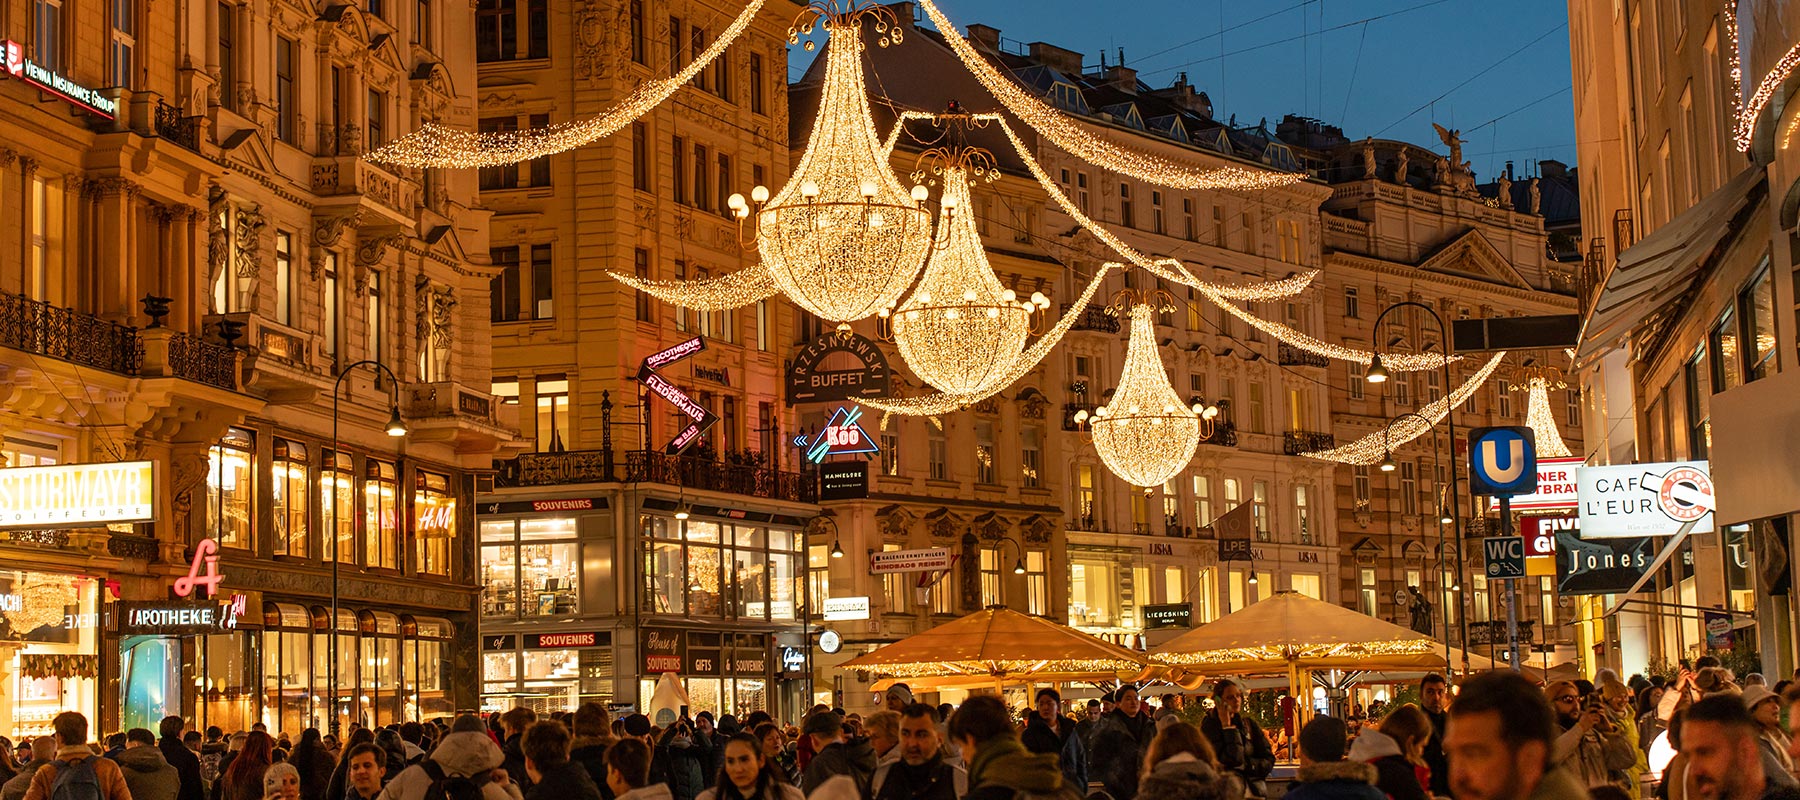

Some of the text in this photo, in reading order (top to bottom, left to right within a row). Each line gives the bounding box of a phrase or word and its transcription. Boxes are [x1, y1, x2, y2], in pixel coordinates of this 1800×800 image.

[647, 338, 701, 365] DISCOTHEQUE
[811, 372, 865, 387] BUFFET
[646, 376, 704, 422] FLEDERMAUS
[682, 425, 698, 440] BAR
[827, 425, 859, 446] Köö
[1482, 439, 1524, 483] U
[1537, 471, 1567, 482] NER
[1667, 471, 1709, 490] TABAK
[0, 468, 141, 511] STURMAYR
[1596, 477, 1638, 493] CAF
[489, 500, 592, 513] of SOUVENIRS
[1587, 499, 1652, 516] L'EUR
[1662, 491, 1699, 517] TRAFIK
[418, 507, 451, 529] H&M
[1150, 543, 1173, 555] LISKA
[1223, 541, 1246, 551] LPE
[1487, 540, 1521, 560] WC
[1299, 551, 1319, 563] LISKA
[1569, 550, 1645, 574] Jones
[135, 609, 212, 625] APOTHEKE
[1147, 611, 1189, 619] LIEBESKIND
[493, 635, 594, 649] of SOUVENIRS
[647, 631, 679, 655] House of
[647, 658, 680, 670] SOUVENIRS
[695, 658, 764, 672] GIFTS & SOUVENIRS
